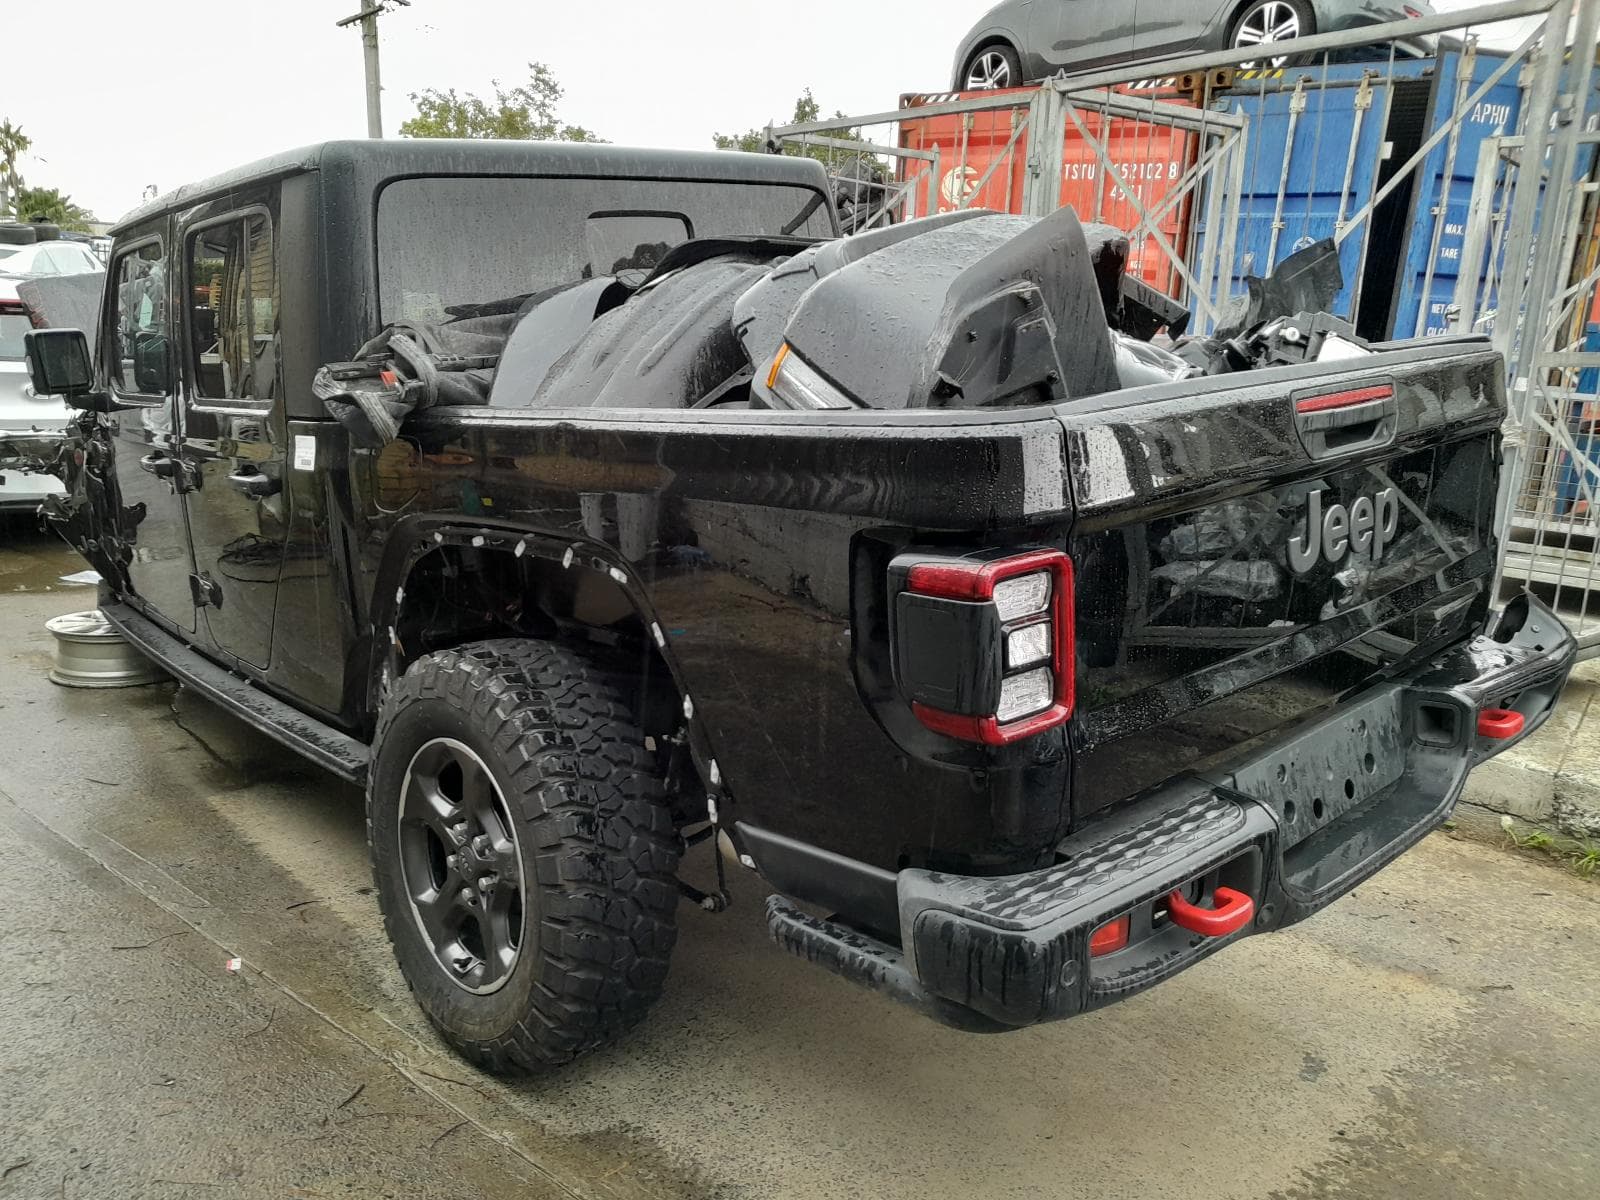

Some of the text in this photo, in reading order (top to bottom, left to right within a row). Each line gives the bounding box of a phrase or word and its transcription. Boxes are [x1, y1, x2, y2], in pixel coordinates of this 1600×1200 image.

[1470, 102, 1510, 126] APHU
[1064, 163, 1096, 180] TSTU
[1445, 223, 1464, 236] MAX.
[1440, 247, 1459, 260] TARE
[1287, 487, 1399, 573] Jeep
